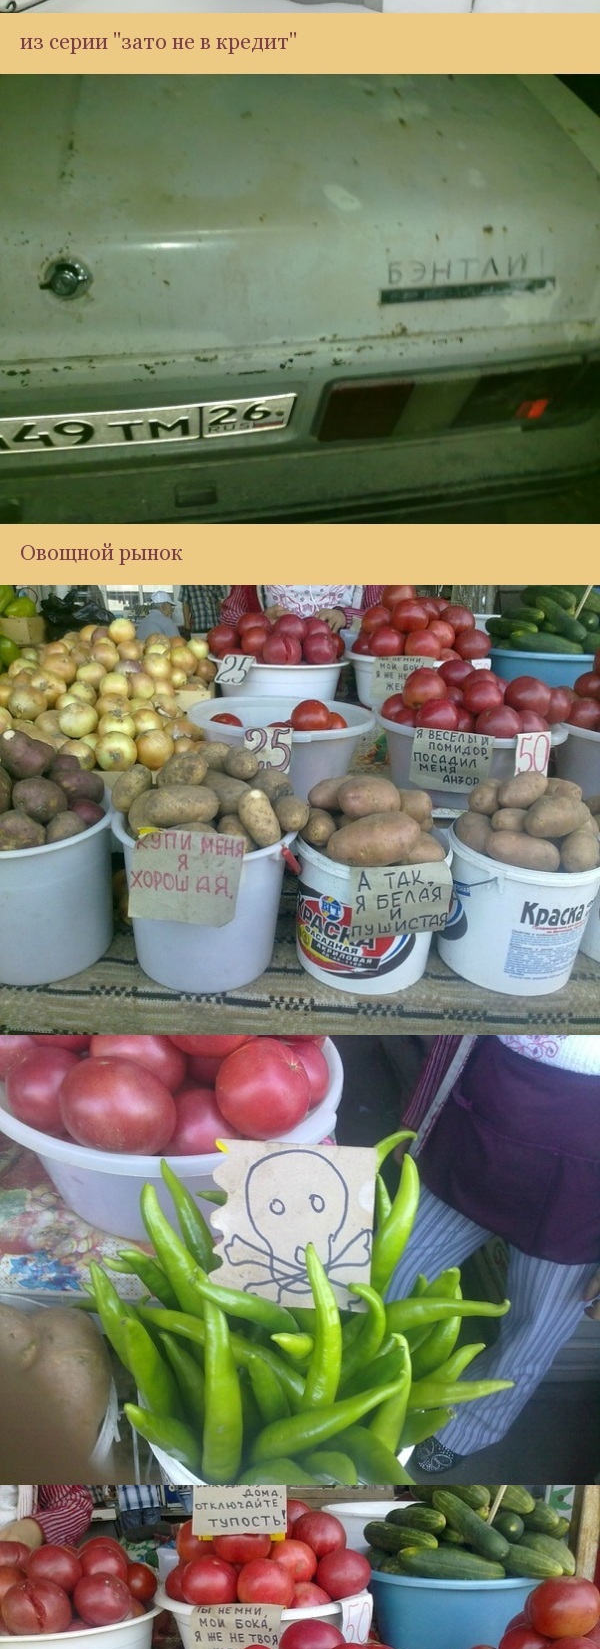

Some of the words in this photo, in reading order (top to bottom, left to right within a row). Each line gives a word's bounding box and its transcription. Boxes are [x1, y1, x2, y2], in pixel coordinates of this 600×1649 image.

[208, 400, 272, 428] 26
[208, 422, 250, 434] RUS
[517, 734, 550, 773] 50
[201, 836, 245, 858] МЕНЯ
[178, 854, 189, 871] Я
[356, 895, 366, 914] Я
[519, 900, 586, 927] Краска
[352, 912, 448, 938] ПУШИСТАЯ
[194, 1631, 202, 1642] Я
[208, 1630, 223, 1642] ЖЕ
[230, 1631, 245, 1642] НЕ
